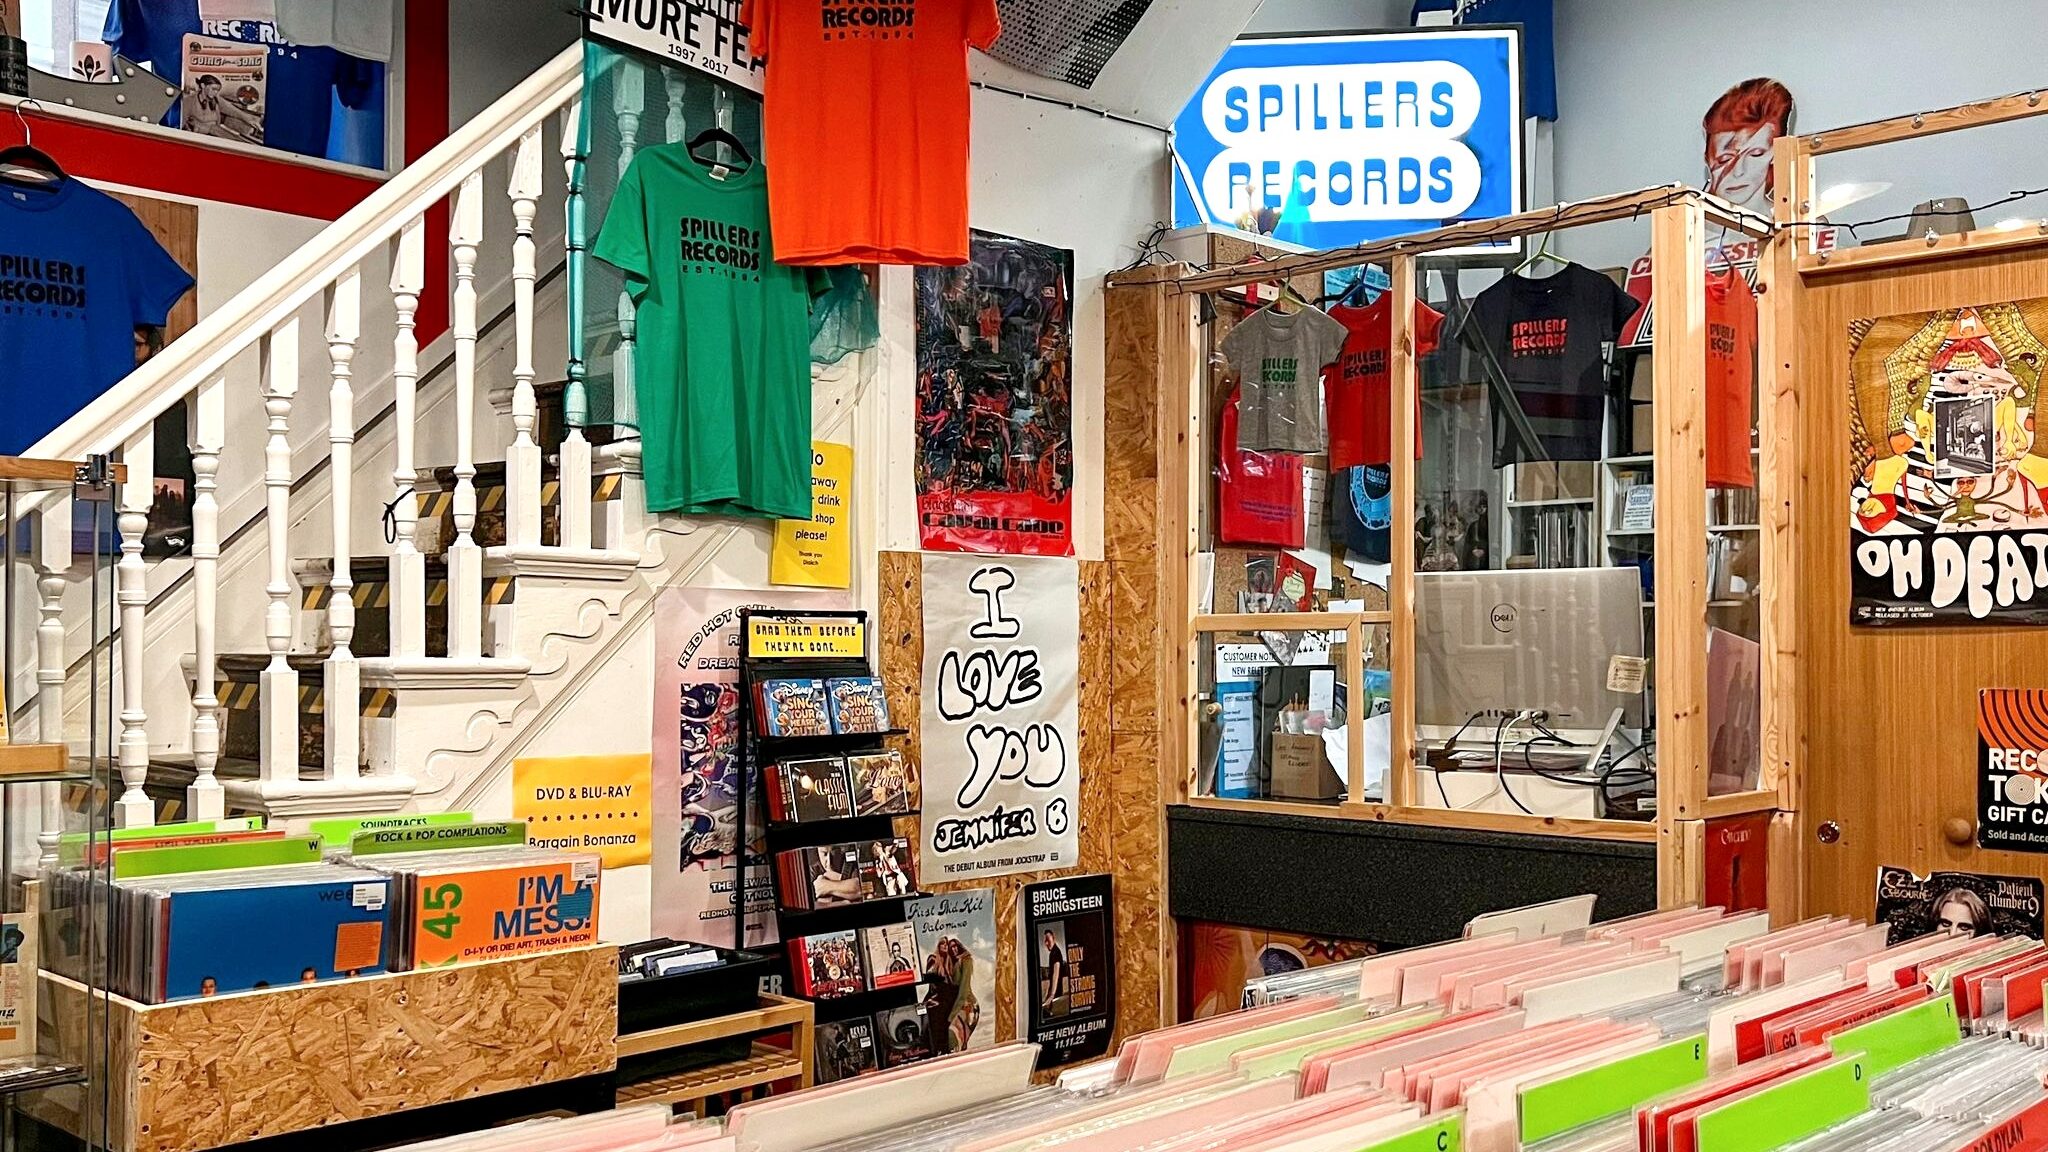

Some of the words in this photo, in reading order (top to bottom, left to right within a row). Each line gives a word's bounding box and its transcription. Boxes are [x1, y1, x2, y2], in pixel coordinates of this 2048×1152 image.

[598, 0, 702, 50] MORE
[822, 7, 916, 28] RECORDS
[668, 43, 696, 63] 1997
[702, 56, 729, 76] 2017
[1225, 81, 1454, 133] SPILLERS
[1229, 156, 1454, 210] RECORDS
[681, 217, 760, 249] SPILLERS
[681, 240, 760, 271] RECORDS
[0, 280, 86, 308] ECORDS
[1513, 318, 1568, 336] SPILLERS
[1513, 333, 1567, 350] RECORDS
[817, 494, 841, 507] drink
[815, 513, 835, 526] shop
[795, 530, 828, 542] please!
[1857, 539, 1923, 598] OH
[969, 566, 1020, 639] I
[677, 631, 704, 670] RED
[702, 608, 733, 637] HOT
[756, 624, 780, 635] GRAB
[785, 625, 813, 636] THEM
[820, 626, 857, 637] BEFORE
[1223, 652, 1258, 661] CUSTOMER
[1232, 666, 1247, 675] NEW
[938, 649, 1043, 721] LOVE
[786, 697, 815, 710] SING
[846, 694, 874, 707] SING
[790, 709, 816, 719] YOUR
[849, 706, 875, 716] YOUR
[850, 715, 876, 724] HEART
[790, 718, 817, 727] HEART
[957, 723, 1066, 809] YOU
[536, 788, 565, 800] DVD
[569, 788, 577, 799] &
[581, 785, 632, 799] BLU-RAY
[815, 777, 847, 796] CLASSIC
[826, 792, 849, 811] FILM
[1046, 797, 1069, 836] B
[1987, 805, 2027, 823] GIFT
[375, 832, 403, 842] ROCK
[406, 831, 413, 840] &
[416, 830, 434, 839] POP
[438, 825, 507, 838] COMPILATIONS
[584, 834, 636, 847] Bonanza
[1987, 829, 2008, 840] Sold
[2009, 832, 2027, 841] and
[308, 840, 318, 850] W
[944, 864, 956, 873] THE
[956, 861, 975, 872] DEBUT
[976, 859, 997, 869] ALBUM
[998, 856, 1014, 867] FROM
[1015, 853, 1046, 865] JOCKSTRAP
[710, 881, 733, 893] THE
[1032, 887, 1067, 903] BRUCE
[421, 882, 464, 940] 45
[1033, 895, 1103, 917] SPRINGSTEEN
[1988, 890, 2030, 910] Number
[2028, 897, 2040, 918] 9
[485, 944, 498, 953] OR
[535, 937, 561, 946] TRASH
[569, 932, 591, 942] NEON
[1037, 1030, 1055, 1043] THE
[1055, 1025, 1076, 1040] NEW
[1077, 1019, 1107, 1035] ALBUM
[1855, 1063, 1862, 1081] D
[1437, 1130, 1448, 1151] C
